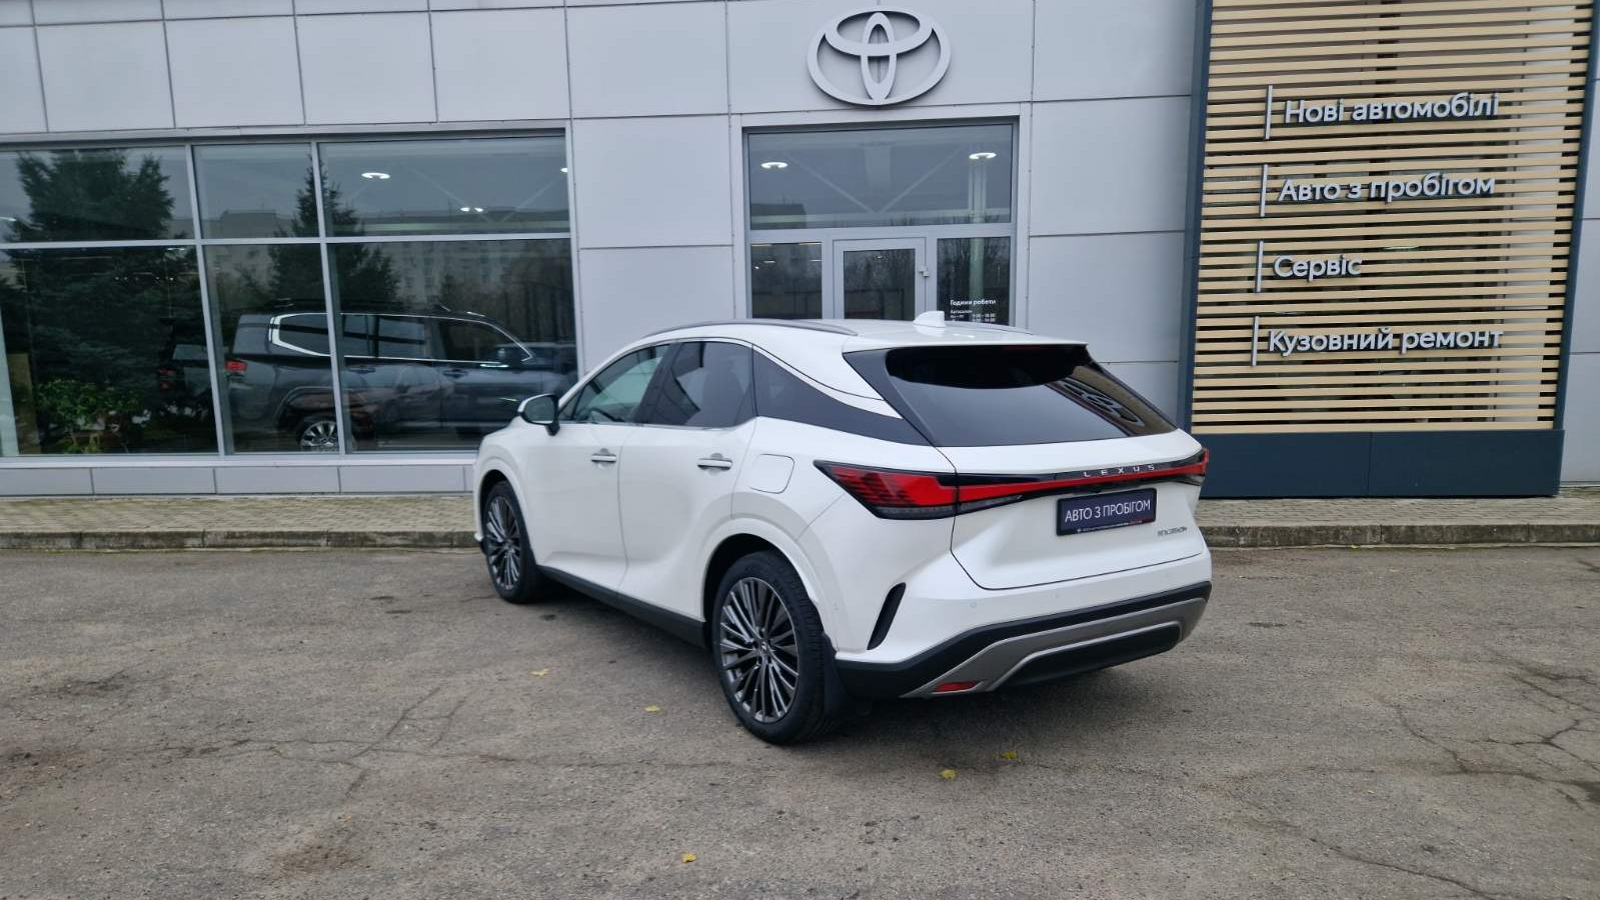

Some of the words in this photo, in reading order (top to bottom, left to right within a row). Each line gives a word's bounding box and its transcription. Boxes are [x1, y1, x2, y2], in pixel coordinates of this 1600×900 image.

[1284, 97, 1345, 124] Нові
[1352, 91, 1500, 121] автомобілі
[1278, 178, 1342, 202] Авто
[1347, 182, 1362, 200] з
[1369, 172, 1496, 204] пробігом
[1273, 253, 1363, 282] Сервіс
[1267, 327, 1394, 357] Кузовний
[1401, 327, 1504, 354] ремонт
[1083, 464, 1155, 478] LEXUS
[1065, 507, 1093, 522] АВТО
[1103, 499, 1151, 517] ПРОБІГОМ
